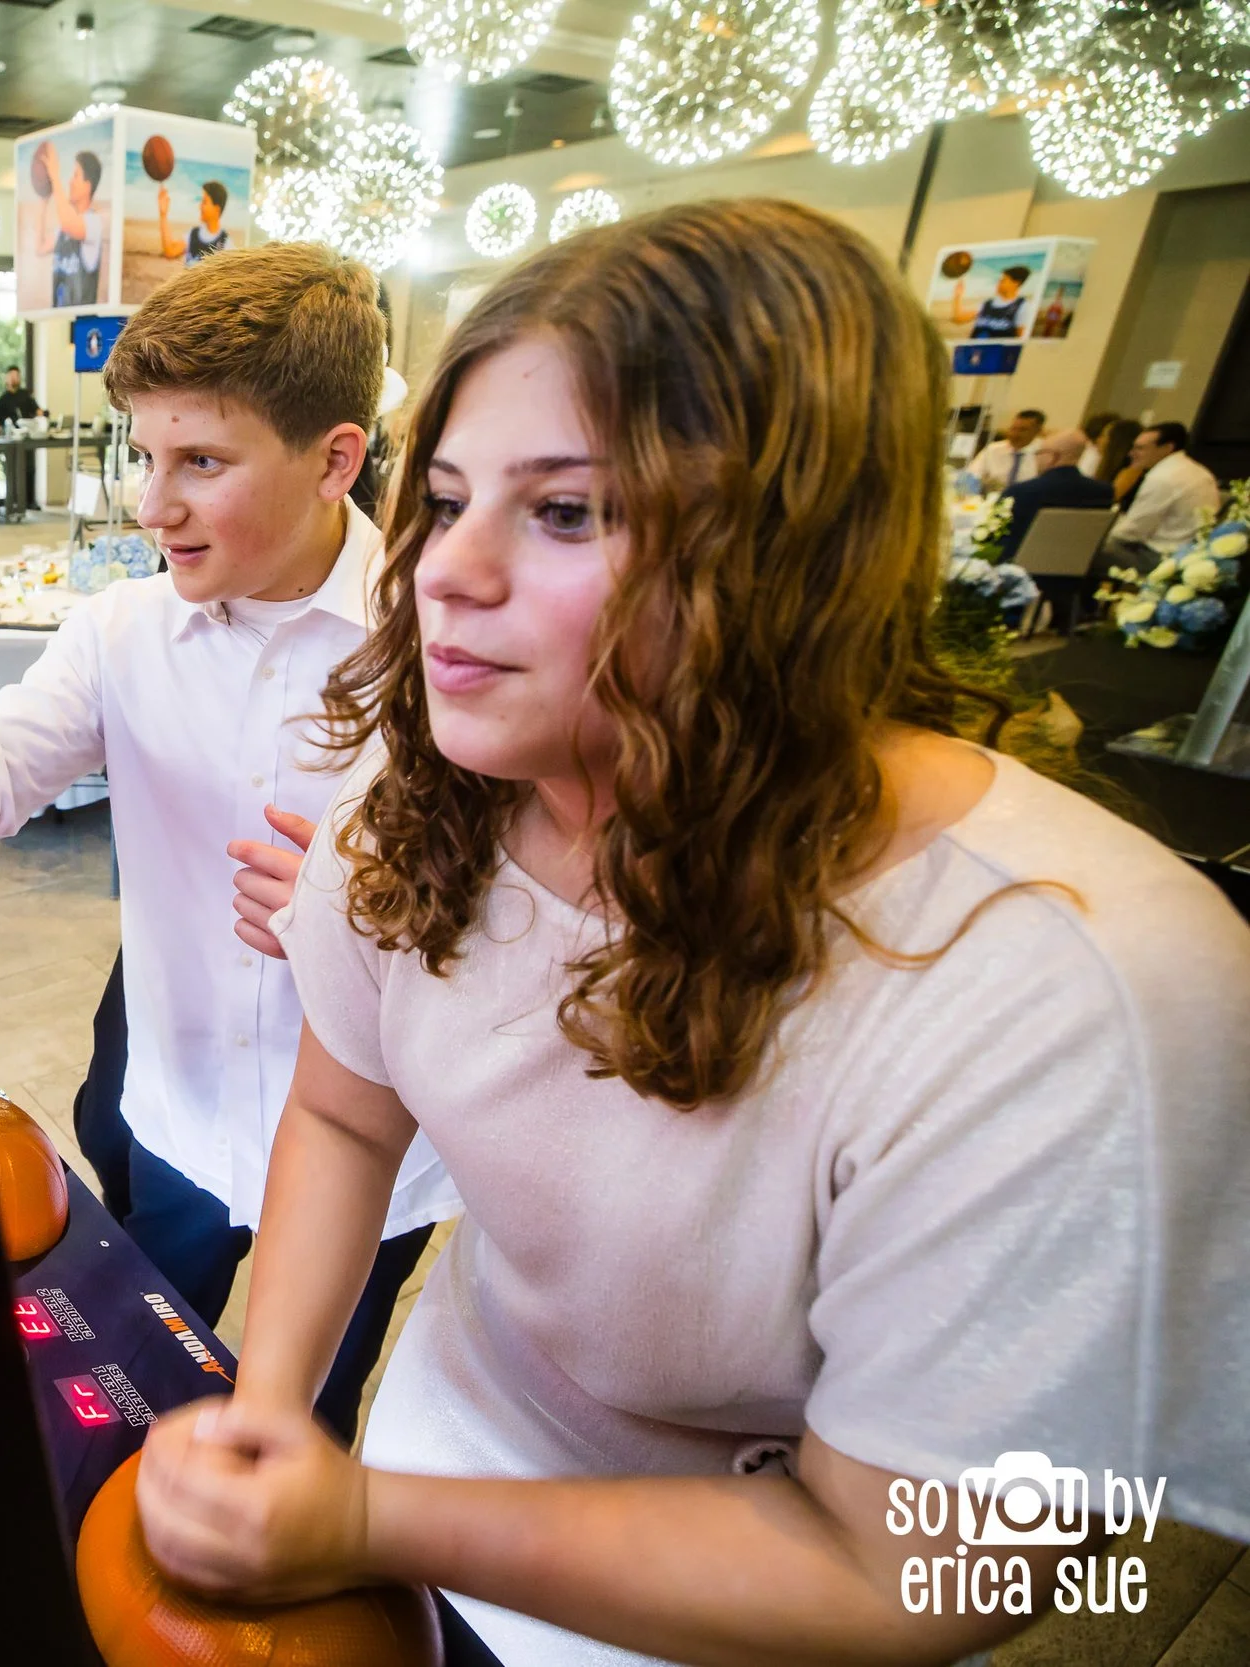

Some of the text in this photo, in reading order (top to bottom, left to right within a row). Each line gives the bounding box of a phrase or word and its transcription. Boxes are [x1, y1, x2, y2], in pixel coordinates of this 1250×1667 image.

[36, 1287, 84, 1342] PLAYER 2
[143, 1293, 231, 1379] ANDAMIRO
[91, 1365, 146, 1427] PLAYER 1
